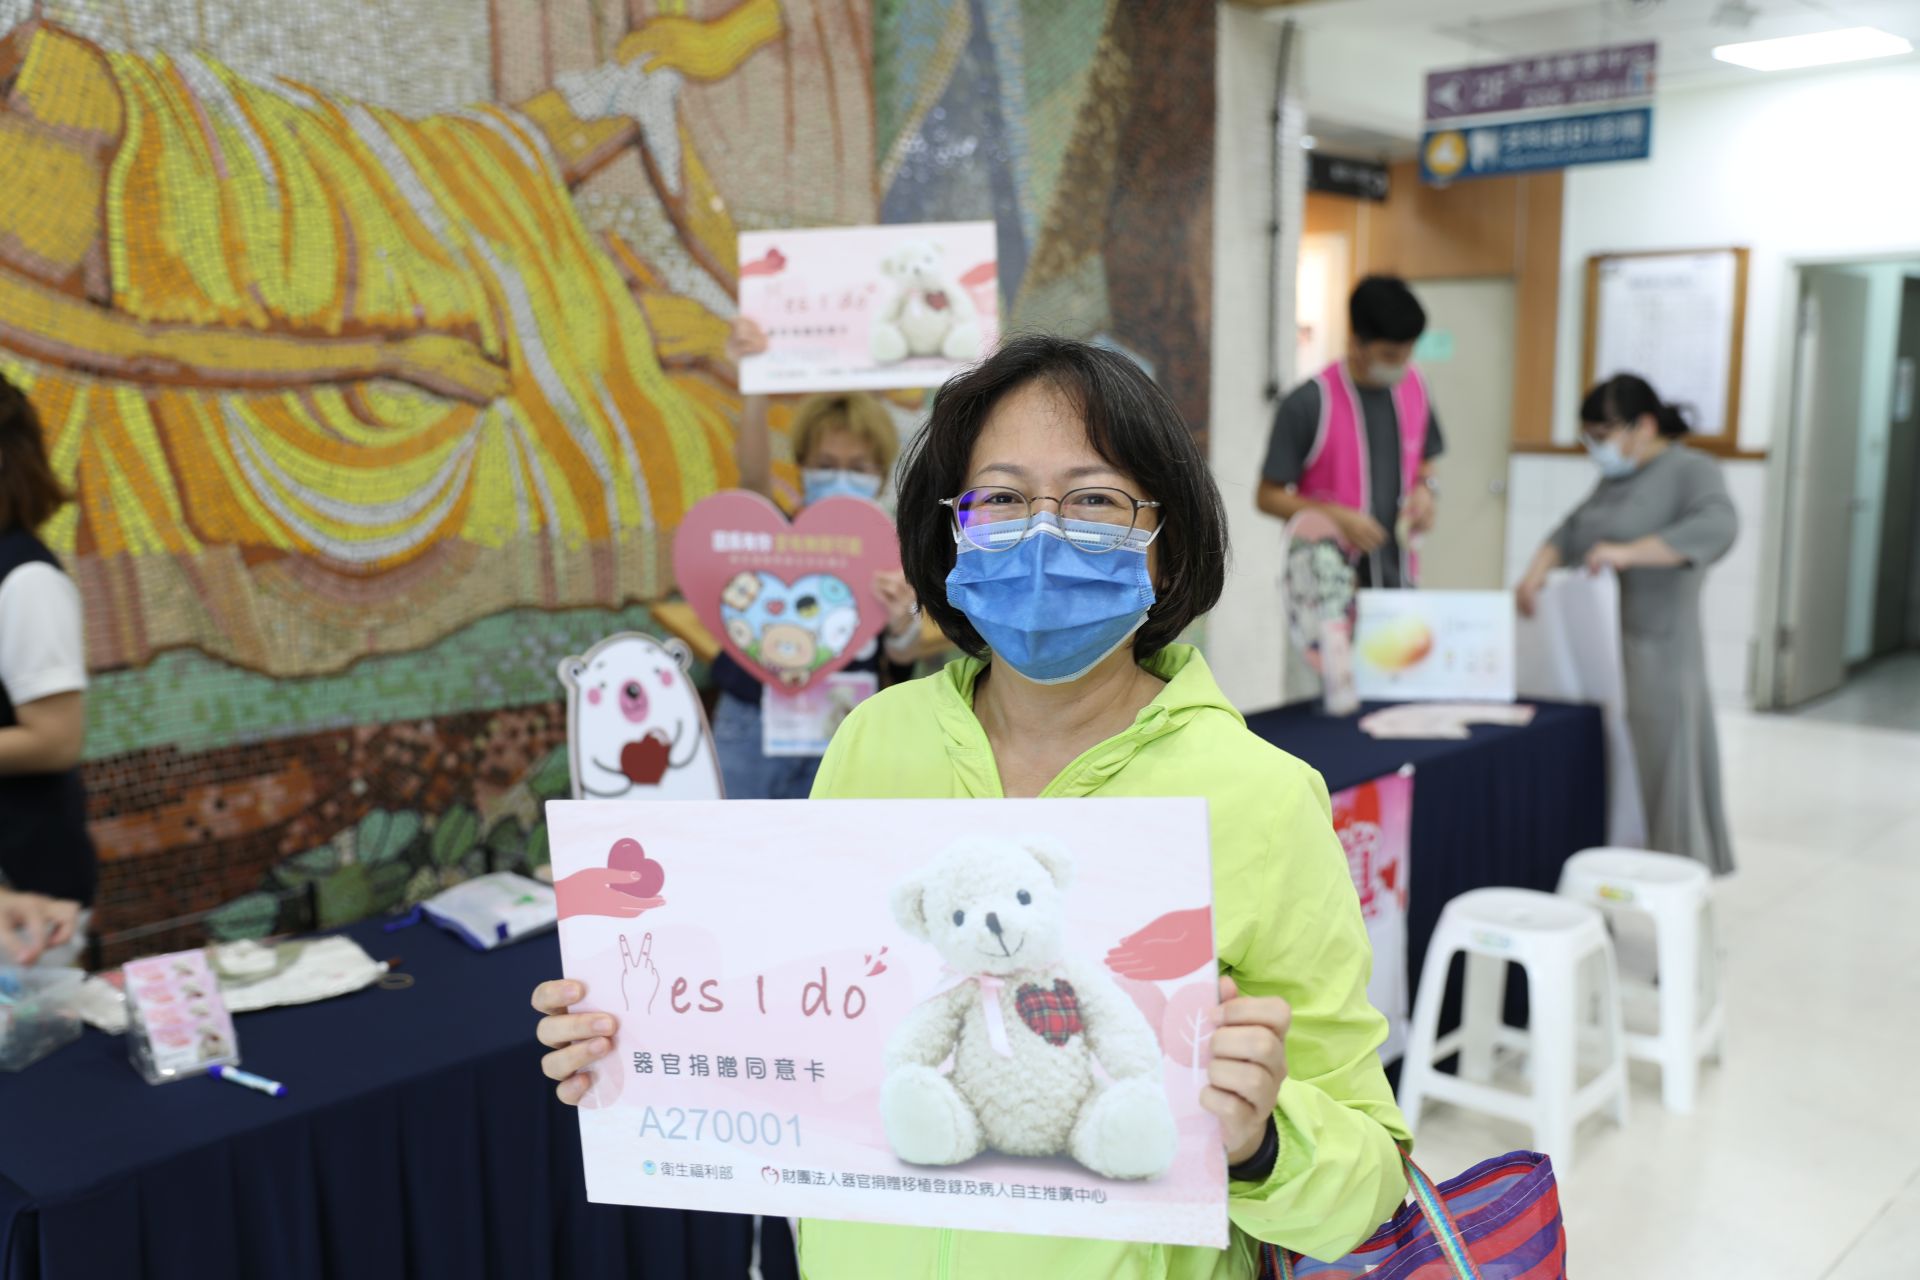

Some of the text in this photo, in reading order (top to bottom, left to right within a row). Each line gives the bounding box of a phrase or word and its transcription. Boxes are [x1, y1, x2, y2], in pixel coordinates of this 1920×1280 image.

[756, 975, 766, 1014] I
[802, 966, 866, 1019] do
[633, 1051, 825, 1082] 器官捐贈同意卡
[639, 1105, 802, 1147] A270001
[661, 1162, 734, 1180] 衛生福利部
[782, 1168, 1107, 1204] 財團法人器官捐贈移植登錄及病人自主推廣中心
